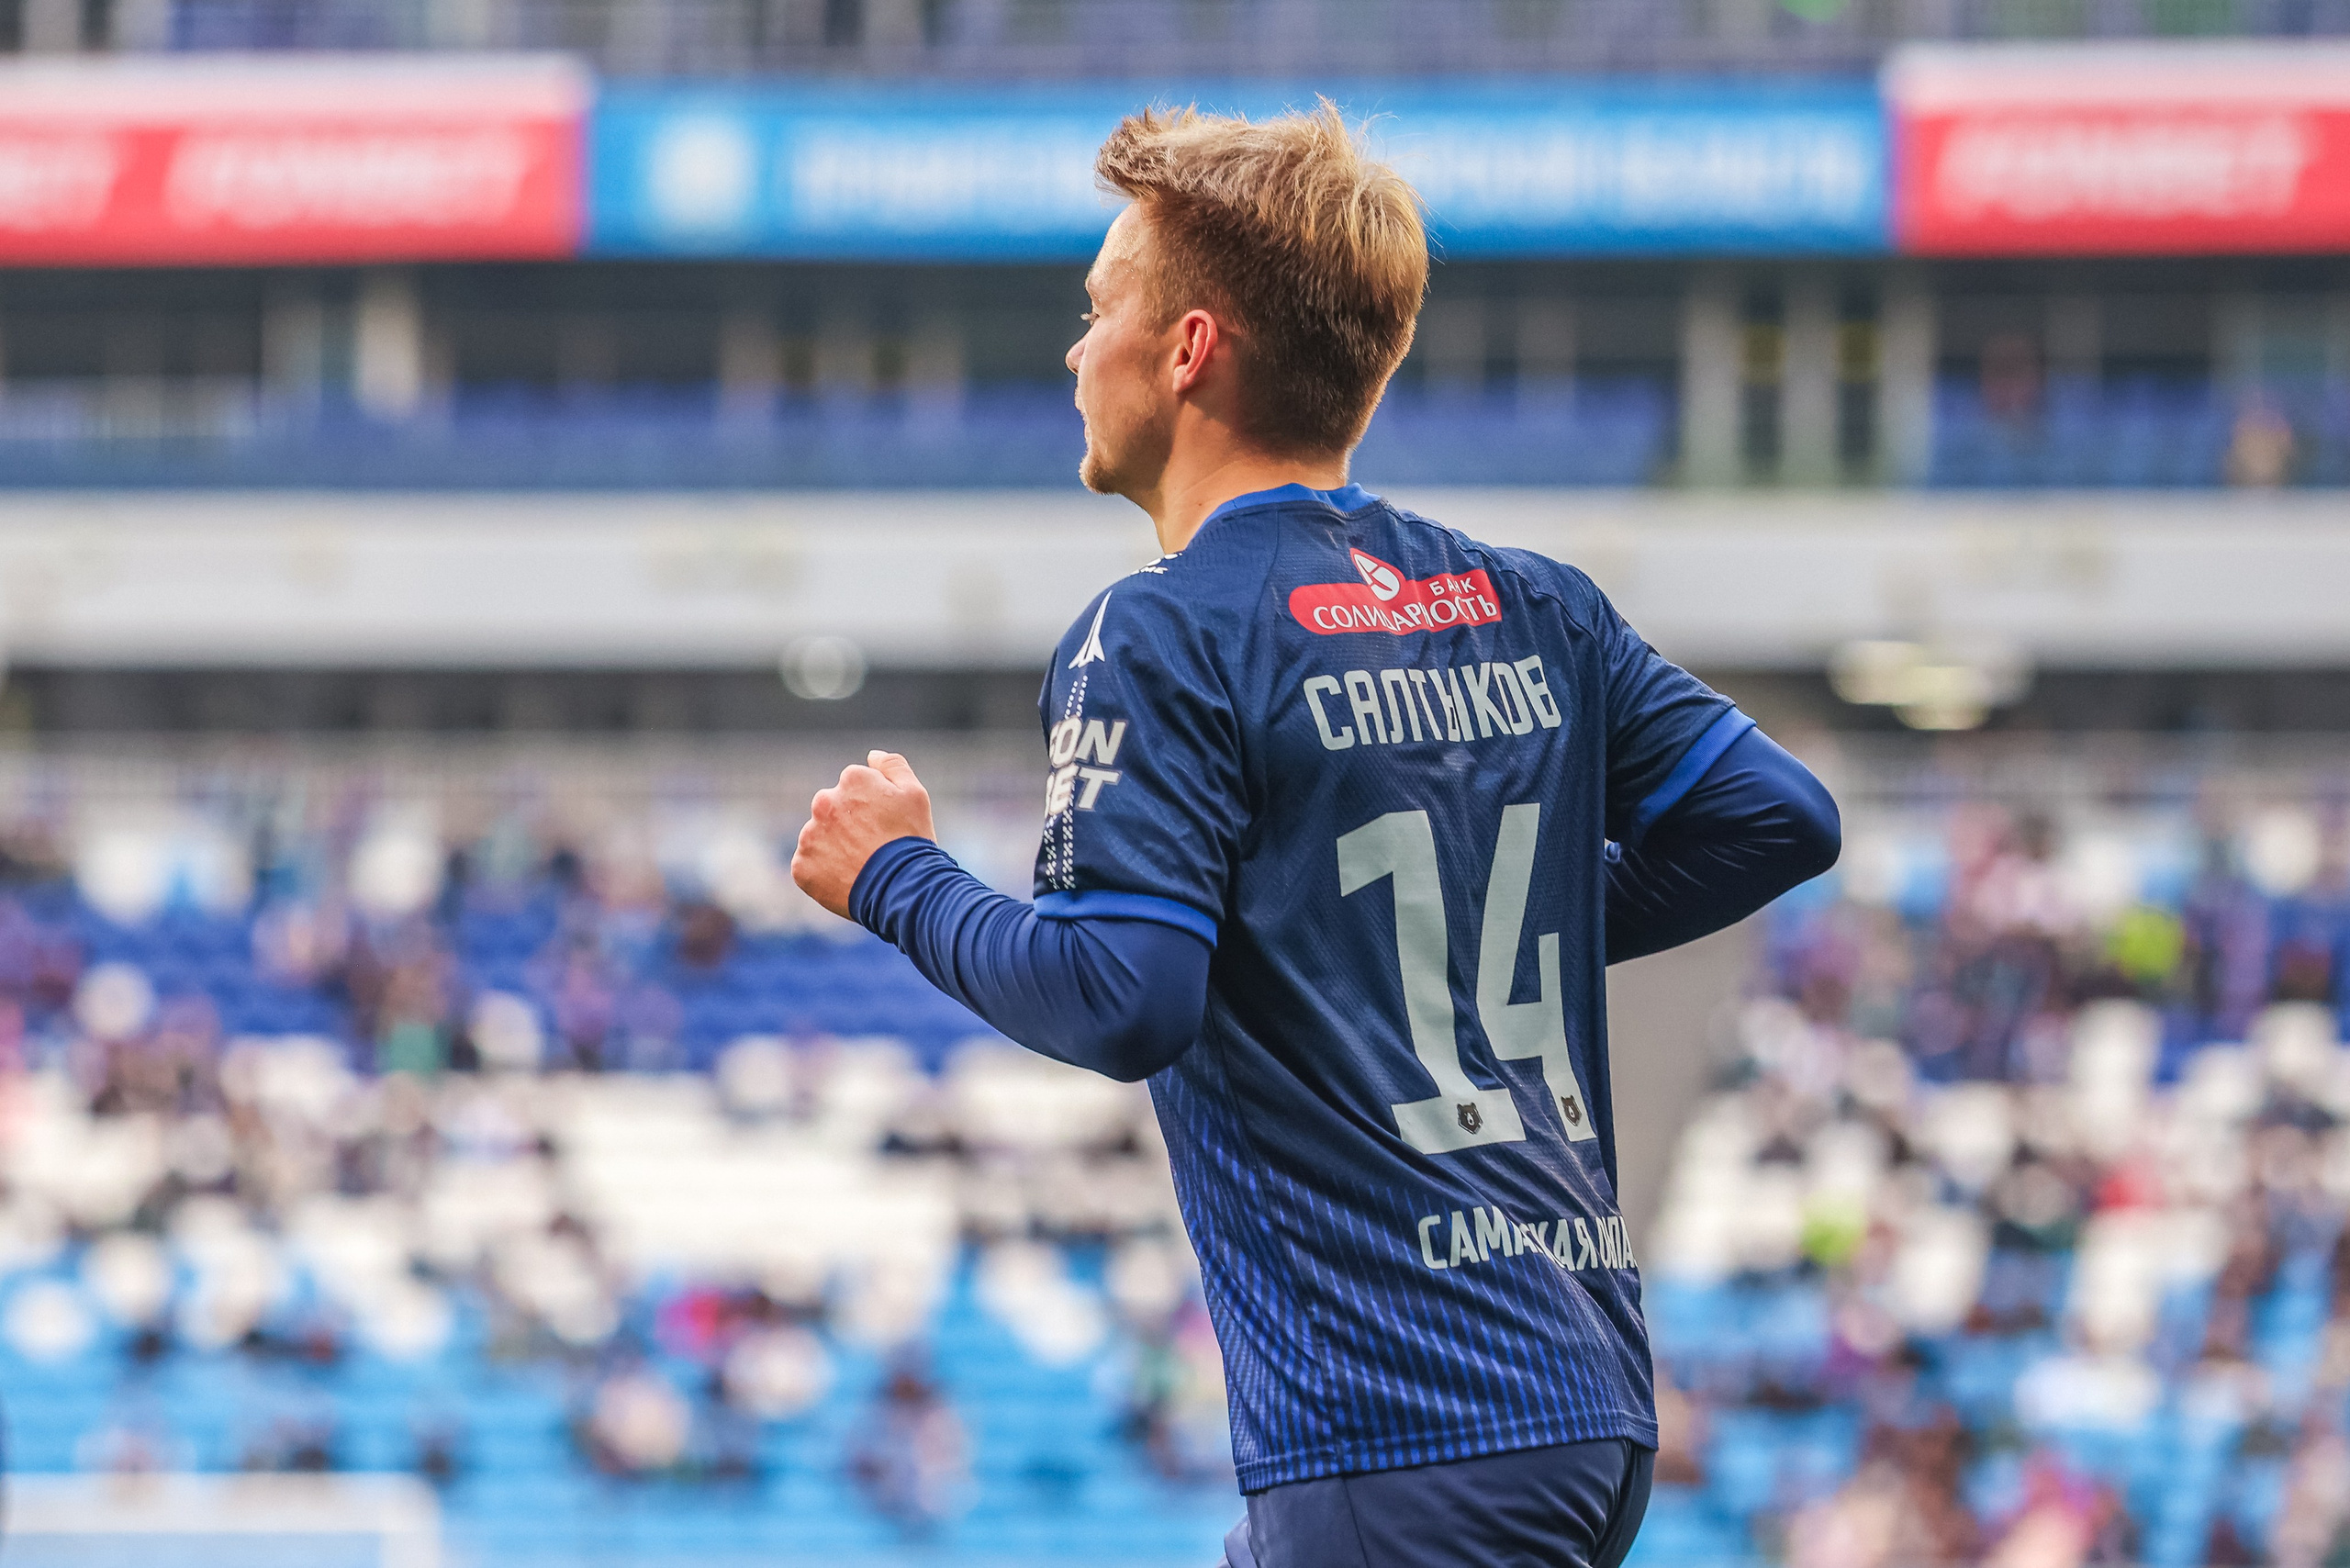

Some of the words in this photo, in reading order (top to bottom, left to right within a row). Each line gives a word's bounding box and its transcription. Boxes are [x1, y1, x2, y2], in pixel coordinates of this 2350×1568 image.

[1303, 655, 1561, 751] САЛТЫКОВ
[1044, 764, 1120, 817] ET
[1337, 802, 1597, 1155] 14
